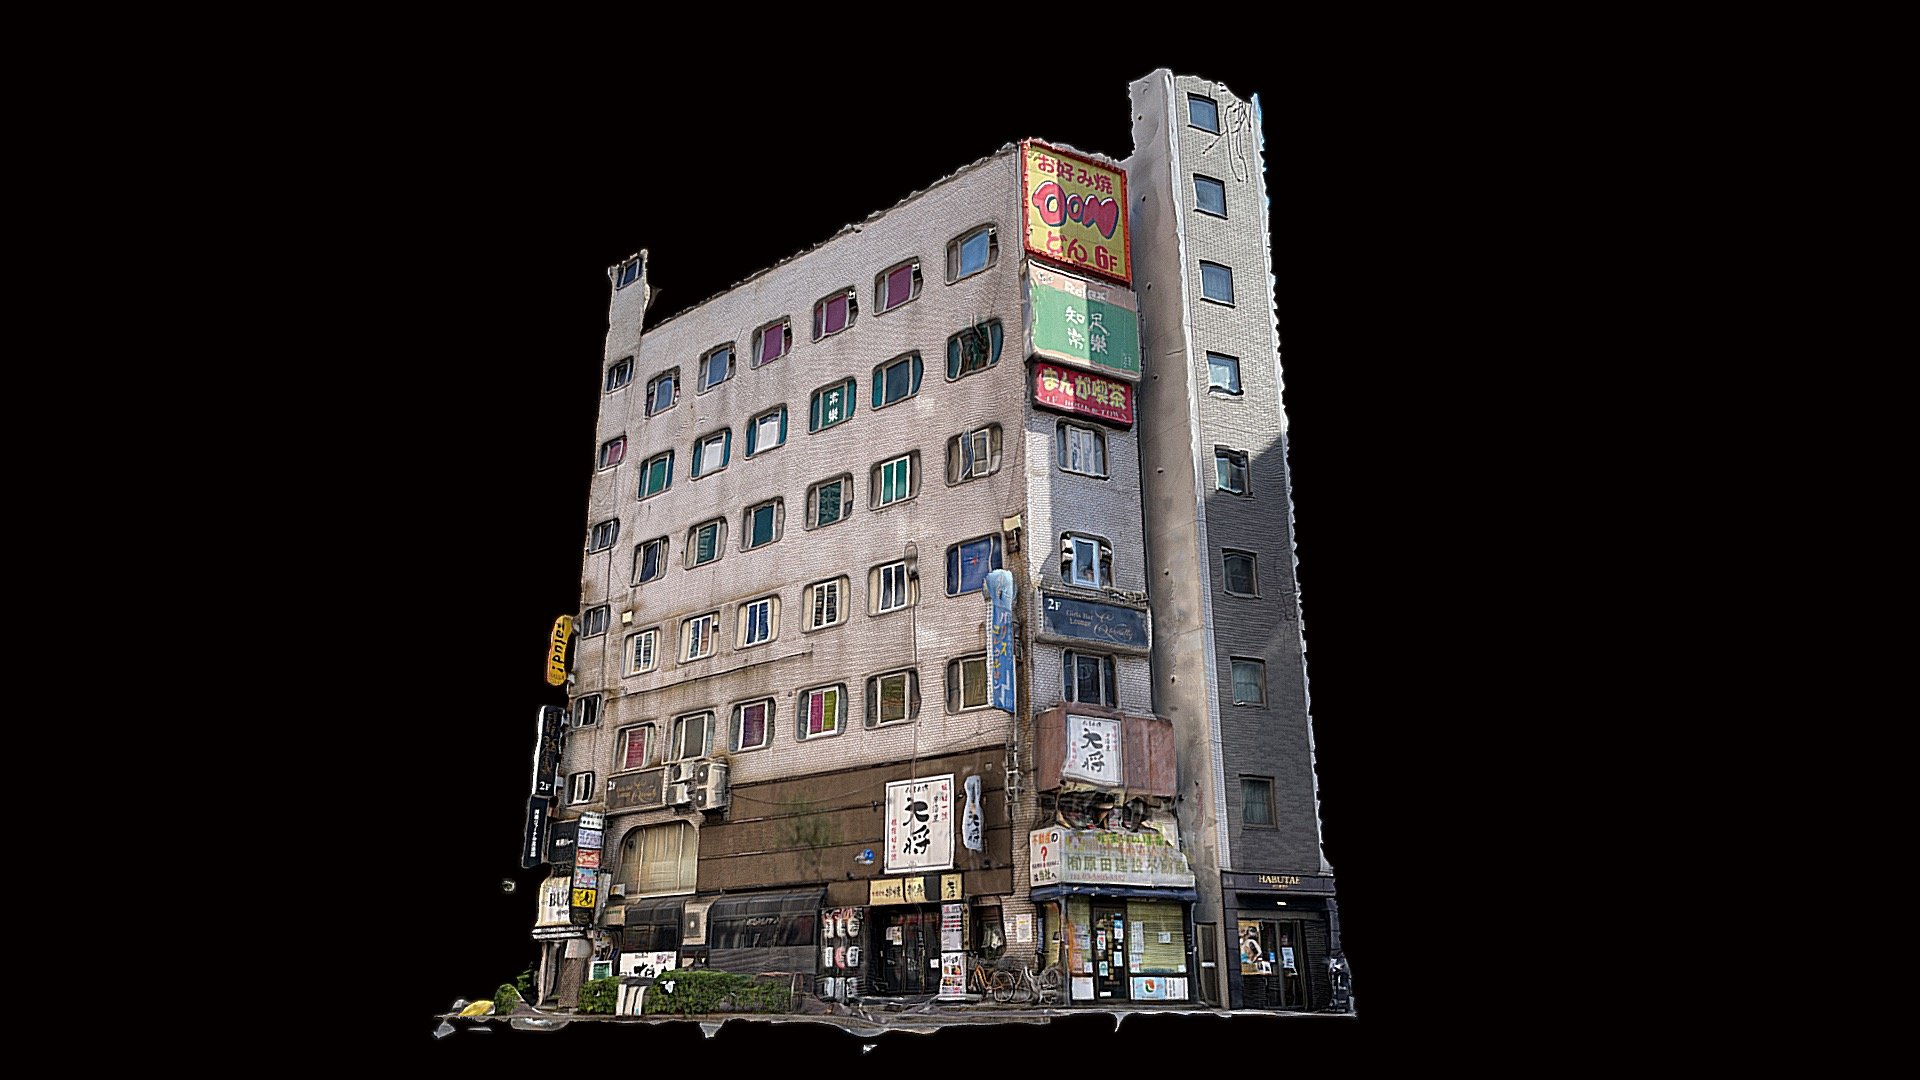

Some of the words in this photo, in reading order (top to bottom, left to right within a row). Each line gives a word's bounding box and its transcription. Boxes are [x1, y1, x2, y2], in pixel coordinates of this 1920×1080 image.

[1037, 154, 1113, 195] お好み焼
[1046, 230, 1088, 263] どん
[1094, 244, 1118, 272] 6F
[1043, 367, 1126, 410] まんが喫茶
[1047, 598, 1062, 611] 2F
[539, 781, 552, 791] 2F
